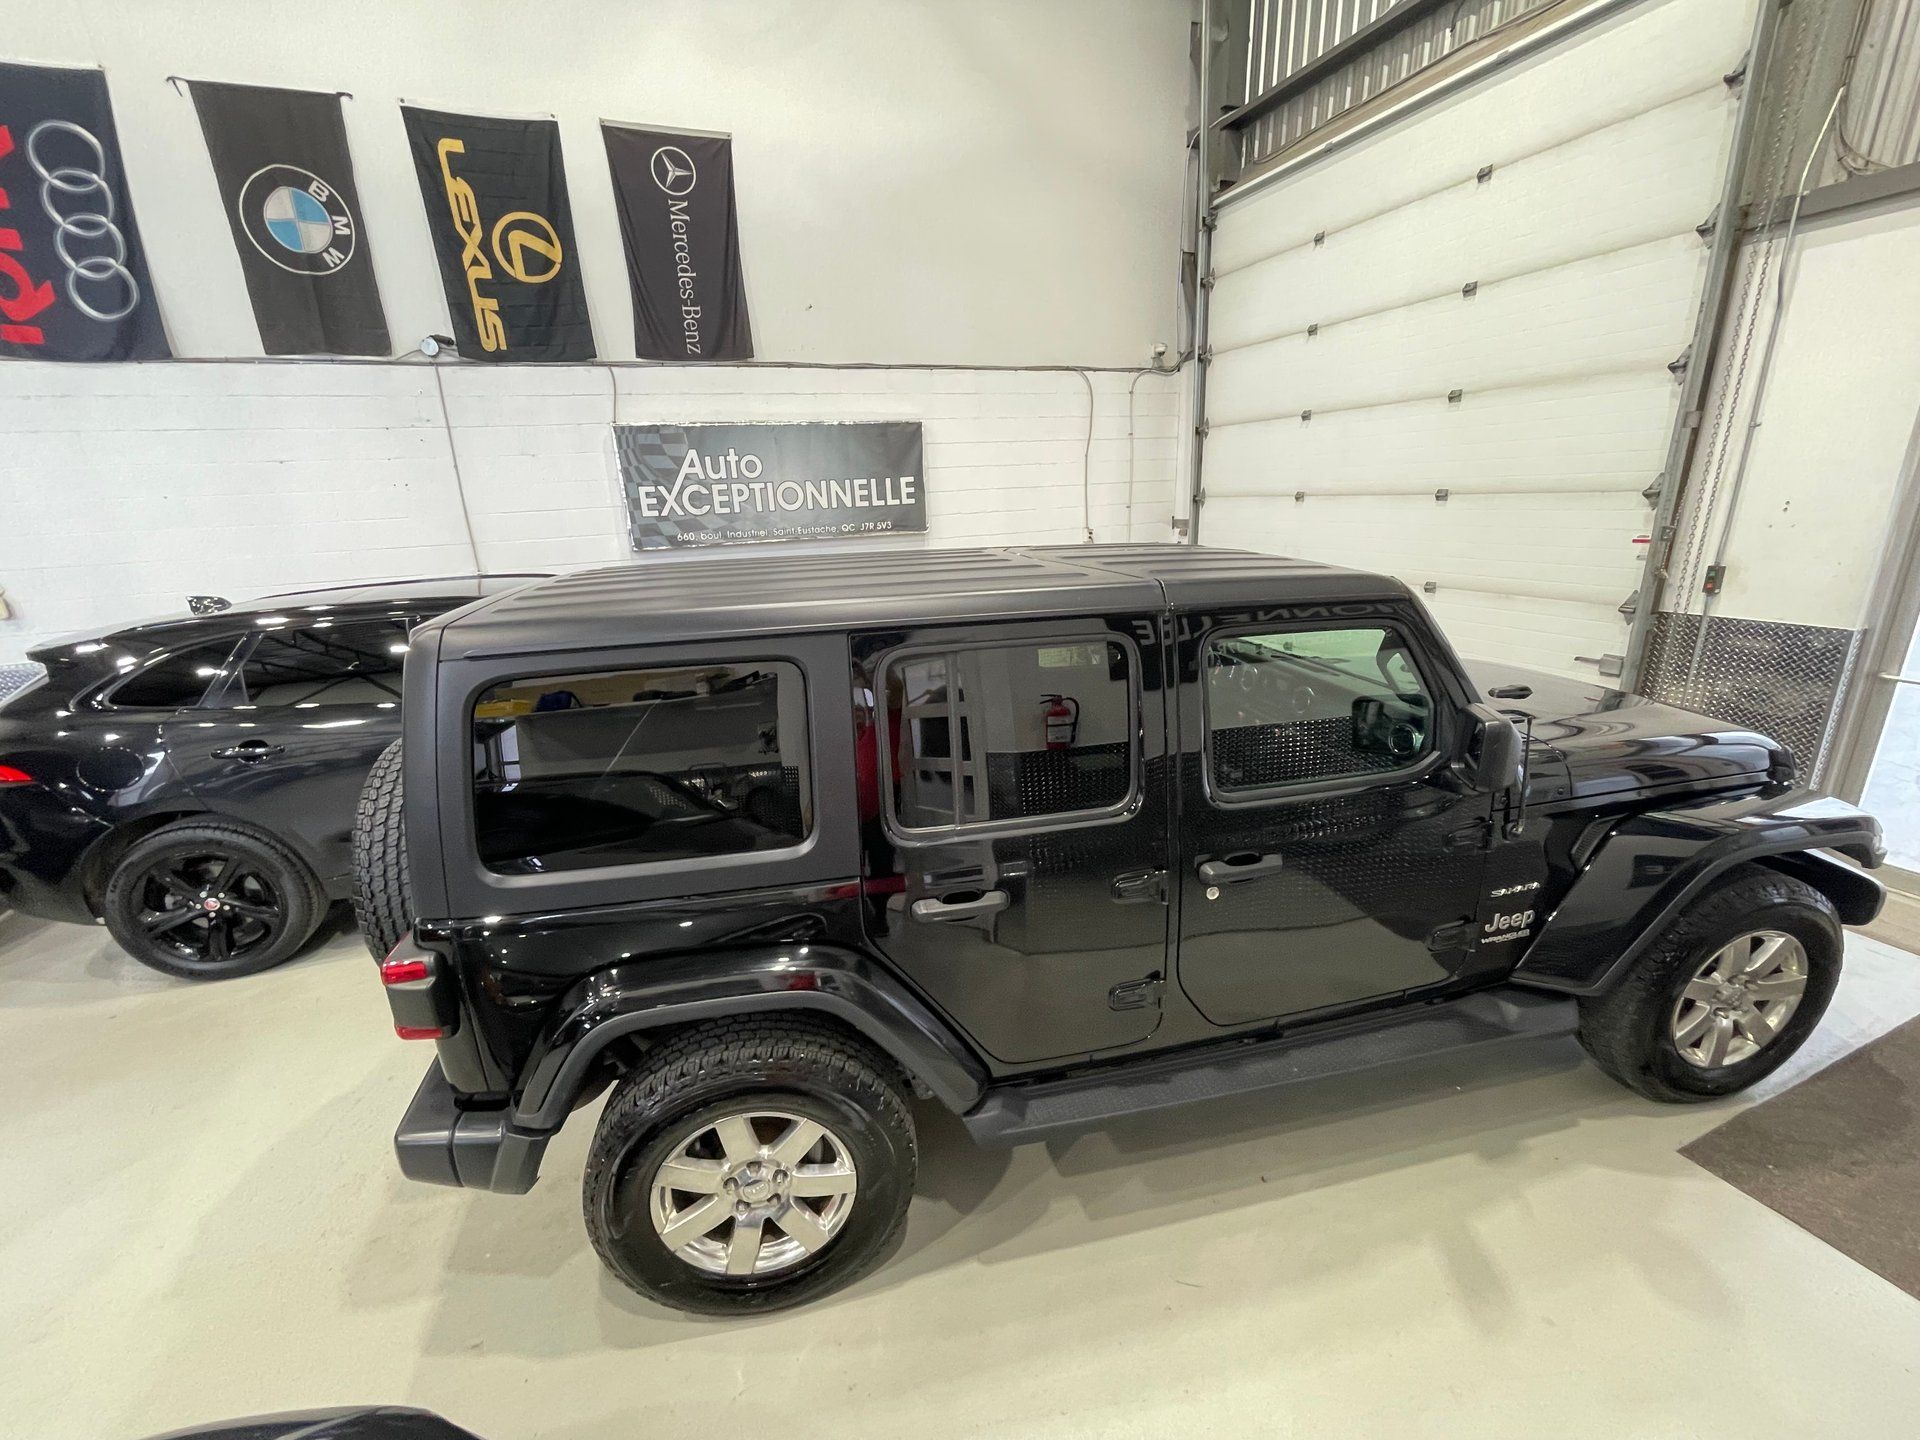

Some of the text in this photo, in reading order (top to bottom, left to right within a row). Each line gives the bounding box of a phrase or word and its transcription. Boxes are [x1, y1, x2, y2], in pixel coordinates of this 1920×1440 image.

[307, 180, 351, 268] BMW
[437, 137, 507, 353] LEXUS
[667, 199, 702, 355] Mercedes-Benz
[676, 448, 763, 481] Auto
[638, 475, 916, 518] EXCEPTIONNELLE
[841, 523, 856, 532] QC
[860, 522, 875, 531] J7R
[876, 521, 892, 530] 5V3
[1484, 909, 1536, 933] Jeep
